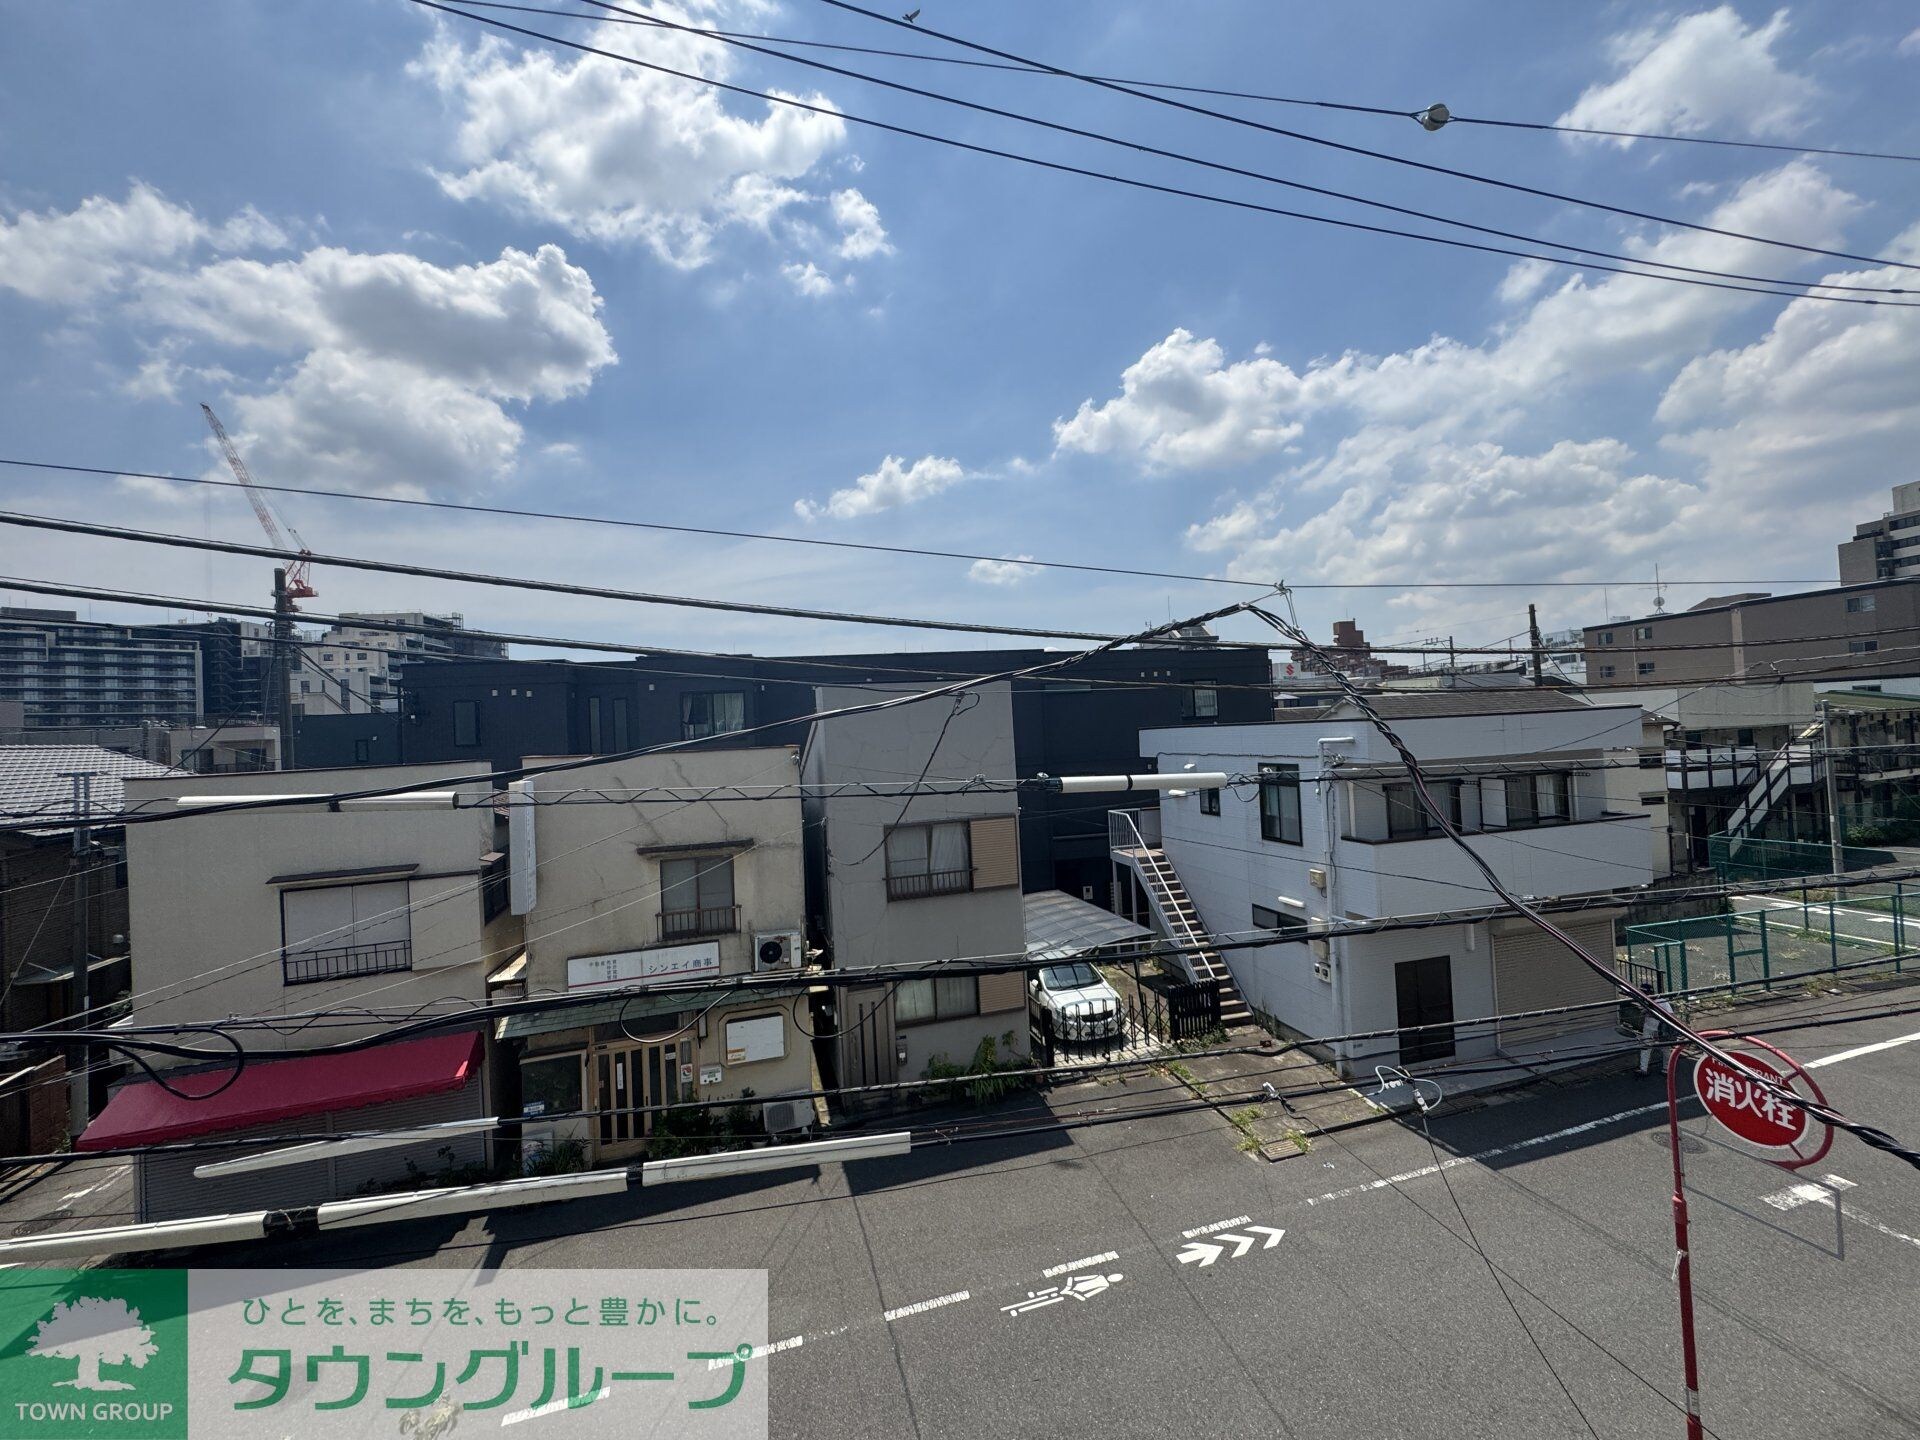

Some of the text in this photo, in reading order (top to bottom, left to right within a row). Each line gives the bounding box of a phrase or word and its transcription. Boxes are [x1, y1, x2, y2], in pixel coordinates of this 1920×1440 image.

[648, 957, 712, 974] シンエイ商事
[1705, 1068, 1797, 1131] 消火栓
